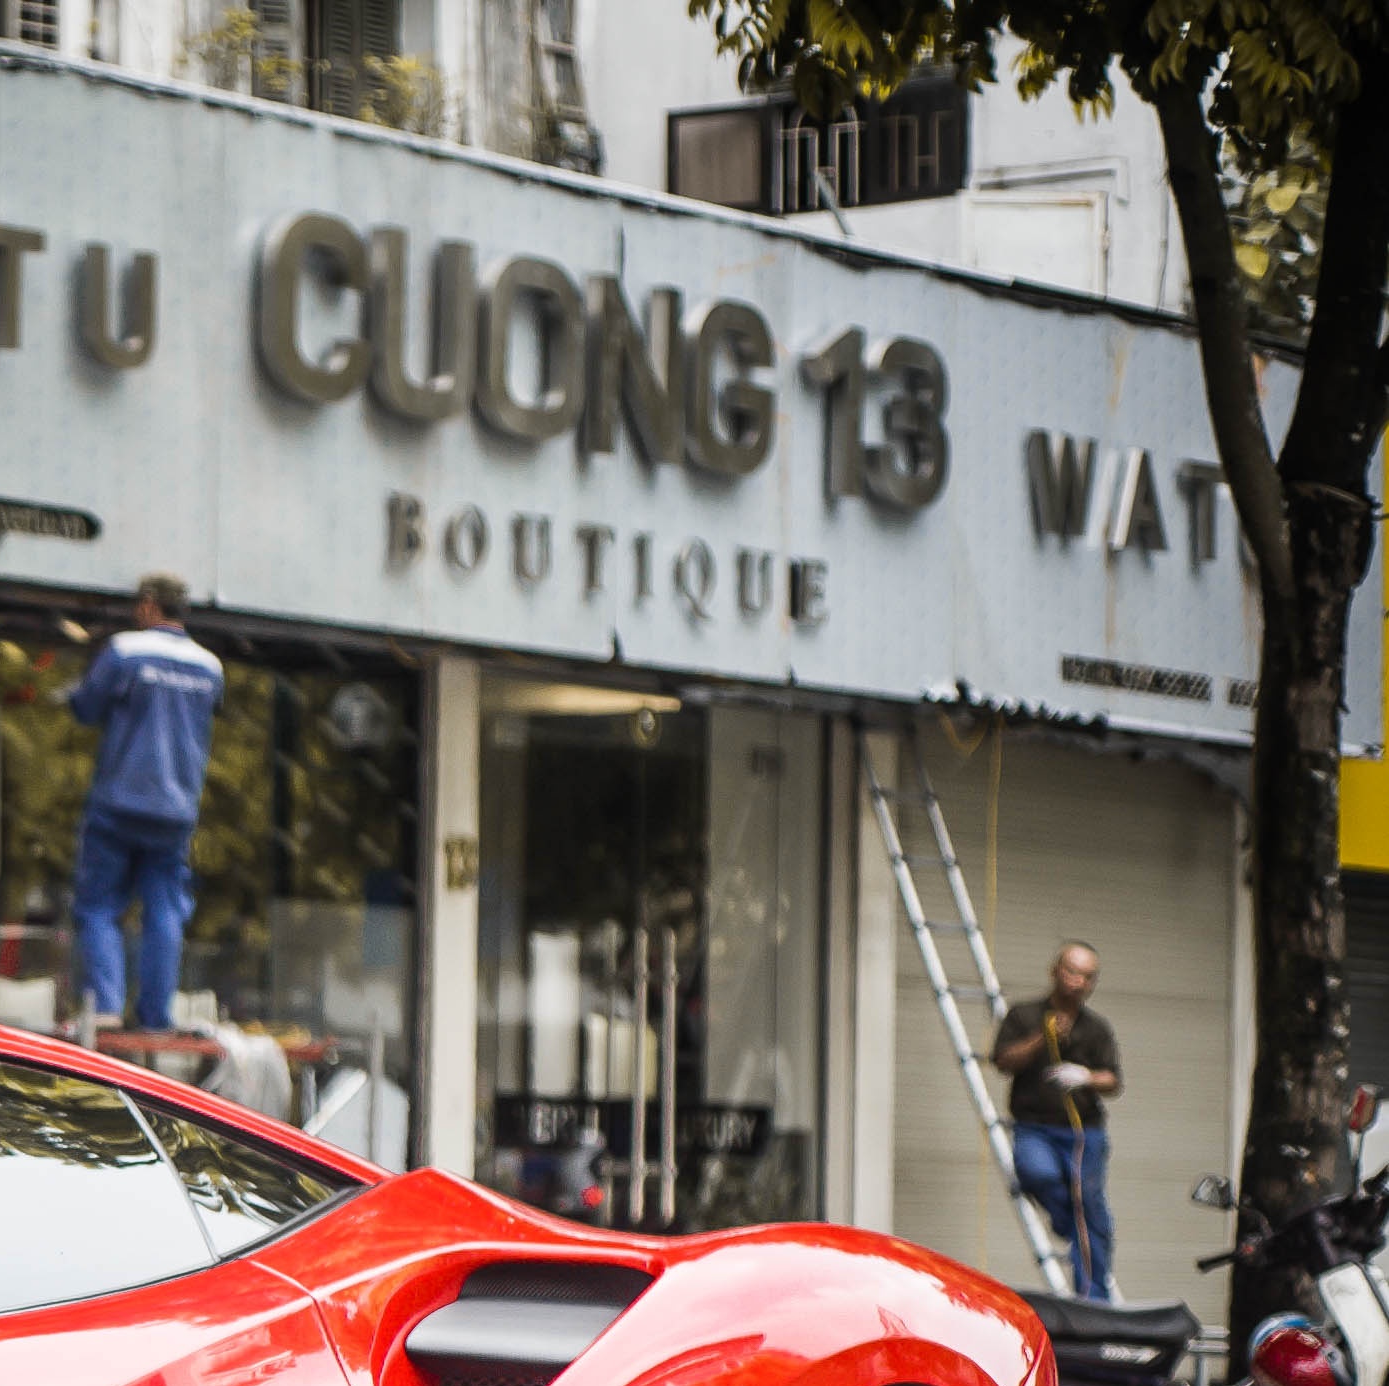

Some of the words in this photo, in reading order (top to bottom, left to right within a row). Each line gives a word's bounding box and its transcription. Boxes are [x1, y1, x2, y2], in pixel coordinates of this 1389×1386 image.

[253, 209, 779, 478] CUONG
[800, 325, 951, 515] 13
[385, 491, 831, 630] BOUTIQUE
[1026, 428, 1235, 572] WAT
